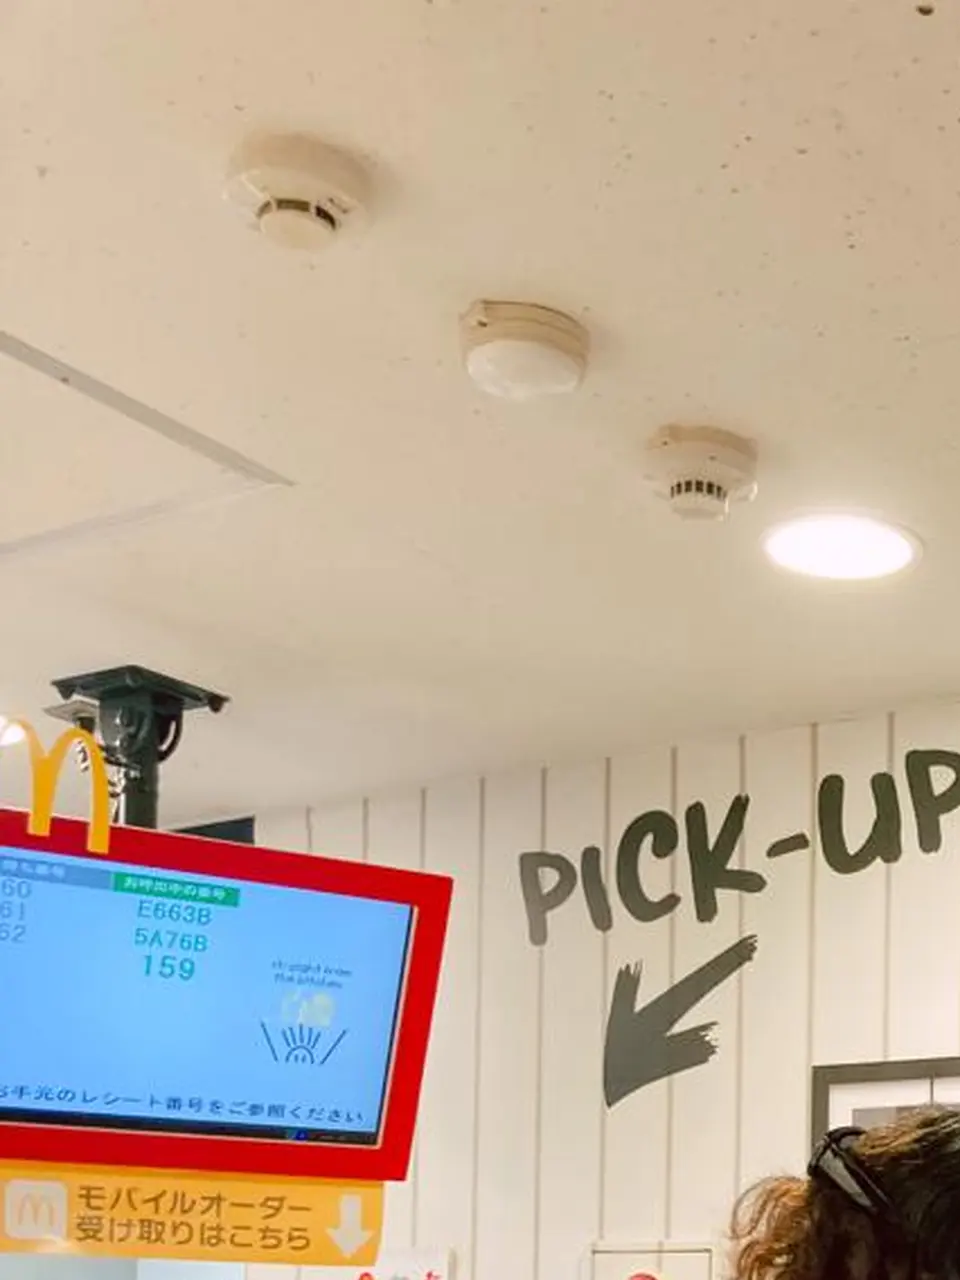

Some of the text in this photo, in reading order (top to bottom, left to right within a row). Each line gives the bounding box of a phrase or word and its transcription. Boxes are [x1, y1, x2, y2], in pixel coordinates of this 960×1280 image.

[137, 899, 212, 926] E663B
[134, 926, 208, 953] 5A76B
[142, 953, 196, 981] 159
[78, 1185, 312, 1220] モバイルオーダー
[76, 1214, 311, 1252] 受け取りはこちら
